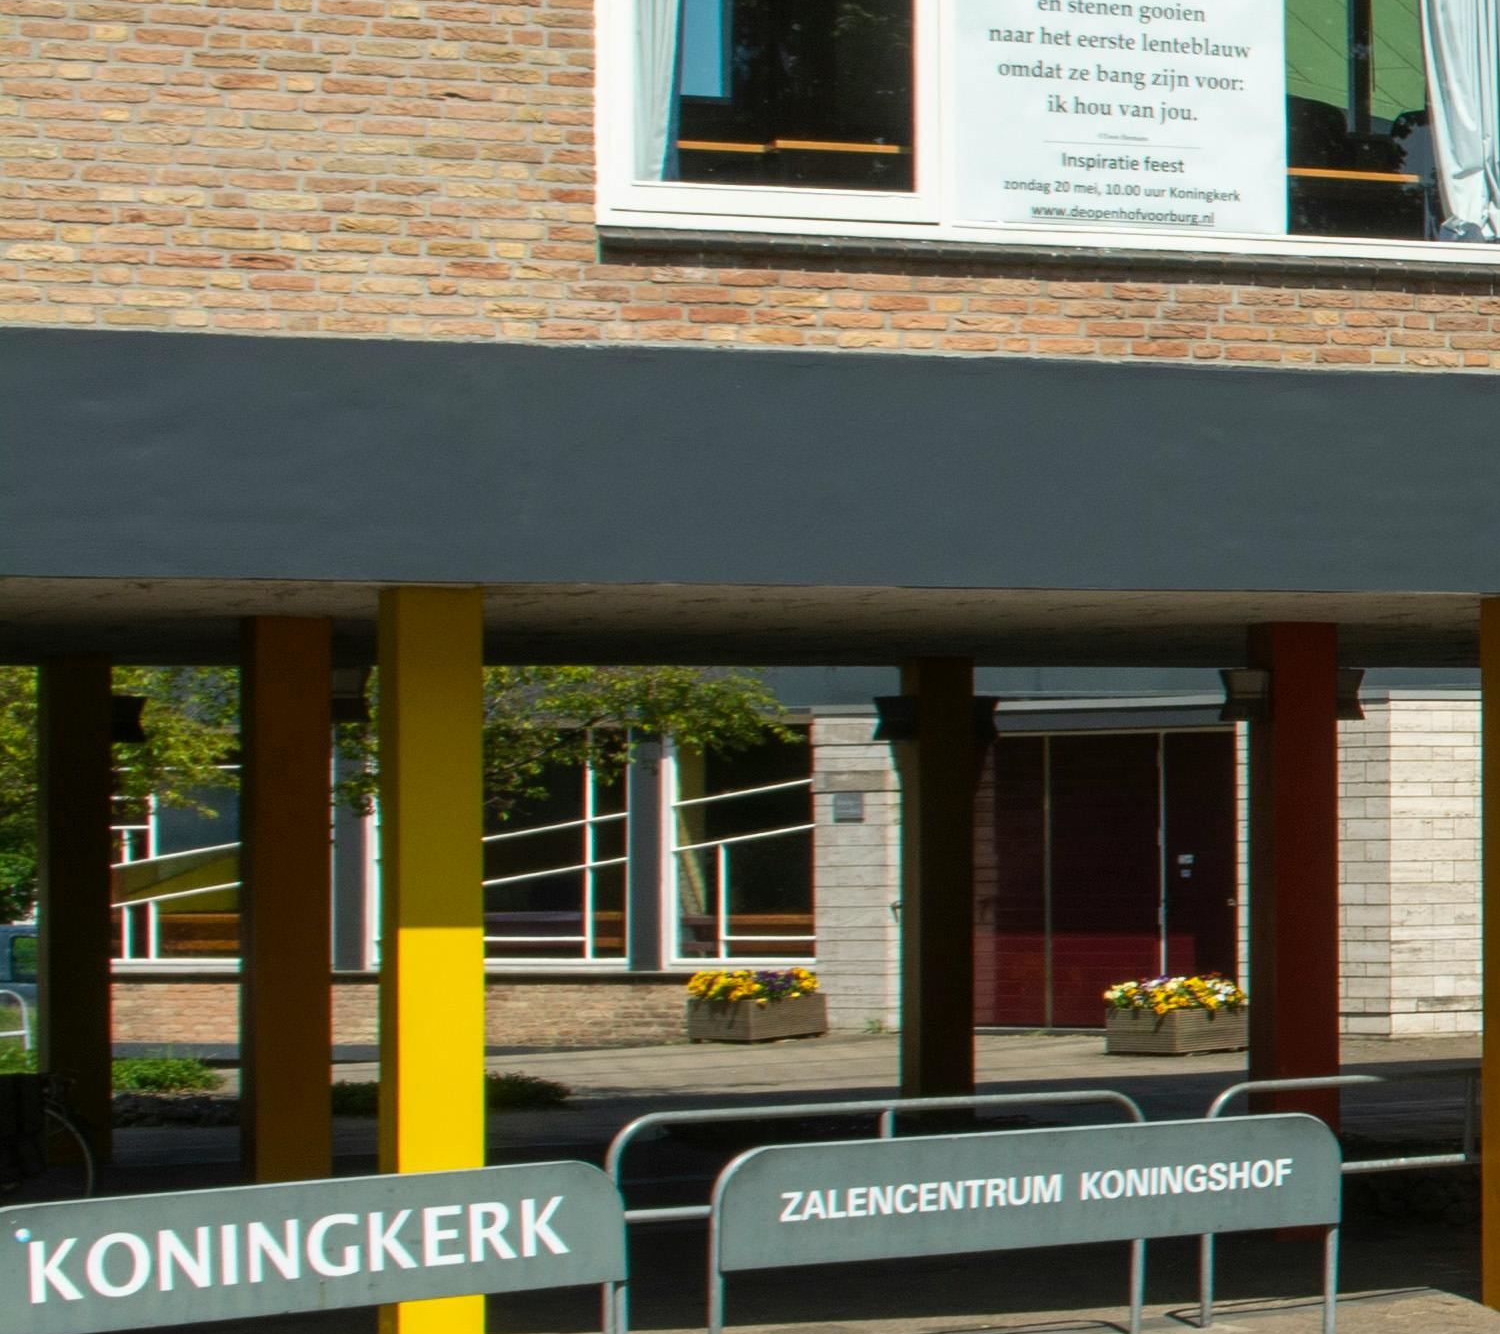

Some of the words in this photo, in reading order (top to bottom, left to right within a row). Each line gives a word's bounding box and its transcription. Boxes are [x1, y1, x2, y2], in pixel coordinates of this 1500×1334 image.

[1037, 0, 1061, 11] en
[1138, 3, 1205, 24] gooien
[989, 29, 1034, 43] naar
[1040, 27, 1071, 46] het
[1077, 34, 1135, 50] eerste
[1142, 33, 1250, 58] lenteblauw
[998, 60, 1062, 79] omdat
[1068, 68, 1090, 81] ze
[1096, 64, 1146, 90] bang
[1151, 69, 1189, 91] zijn
[1195, 76, 1243, 91] voor:
[1048, 95, 1068, 113] ik
[1074, 96, 1112, 115] hou
[1118, 104, 1154, 118] van
[1160, 102, 1197, 124] jou.
[1062, 153, 1140, 171] Inspiratie
[1144, 156, 1184, 173] feest
[1004, 179, 1051, 194] zondag
[1054, 181, 1070, 192] 20
[1074, 183, 1101, 195] mei,
[1106, 184, 1140, 196] 10.00
[1144, 189, 1167, 197] uur
[1169, 187, 1240, 203] Koningkerk
[778, 1173, 1064, 1223] ZALENCENTRUM
[1079, 1158, 1293, 1202] KONINGSHOF
[28, 1195, 571, 1305] KONINGKERK
